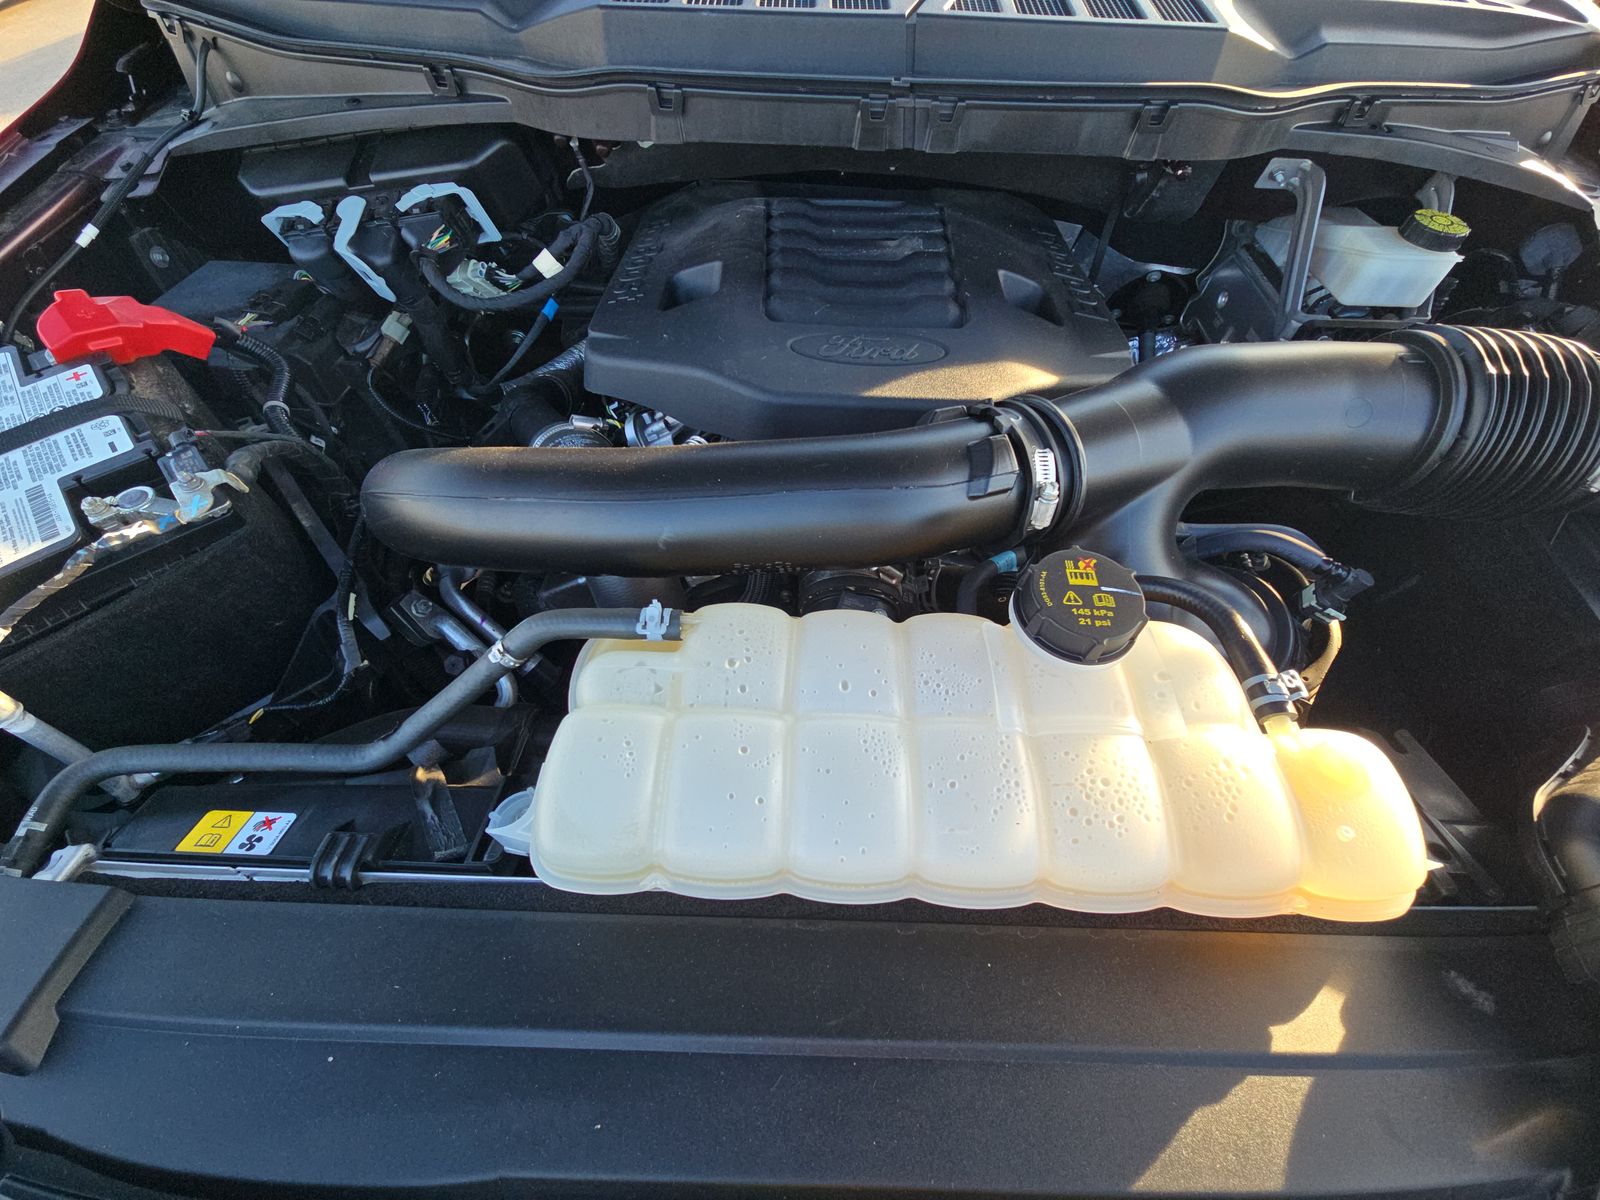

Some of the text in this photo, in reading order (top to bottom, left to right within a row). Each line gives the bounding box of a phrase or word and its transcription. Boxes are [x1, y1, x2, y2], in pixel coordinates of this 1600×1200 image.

[818, 335, 920, 361] Ford
[1071, 608, 1114, 617] 145 kPa
[1094, 619, 1111, 627] psi
